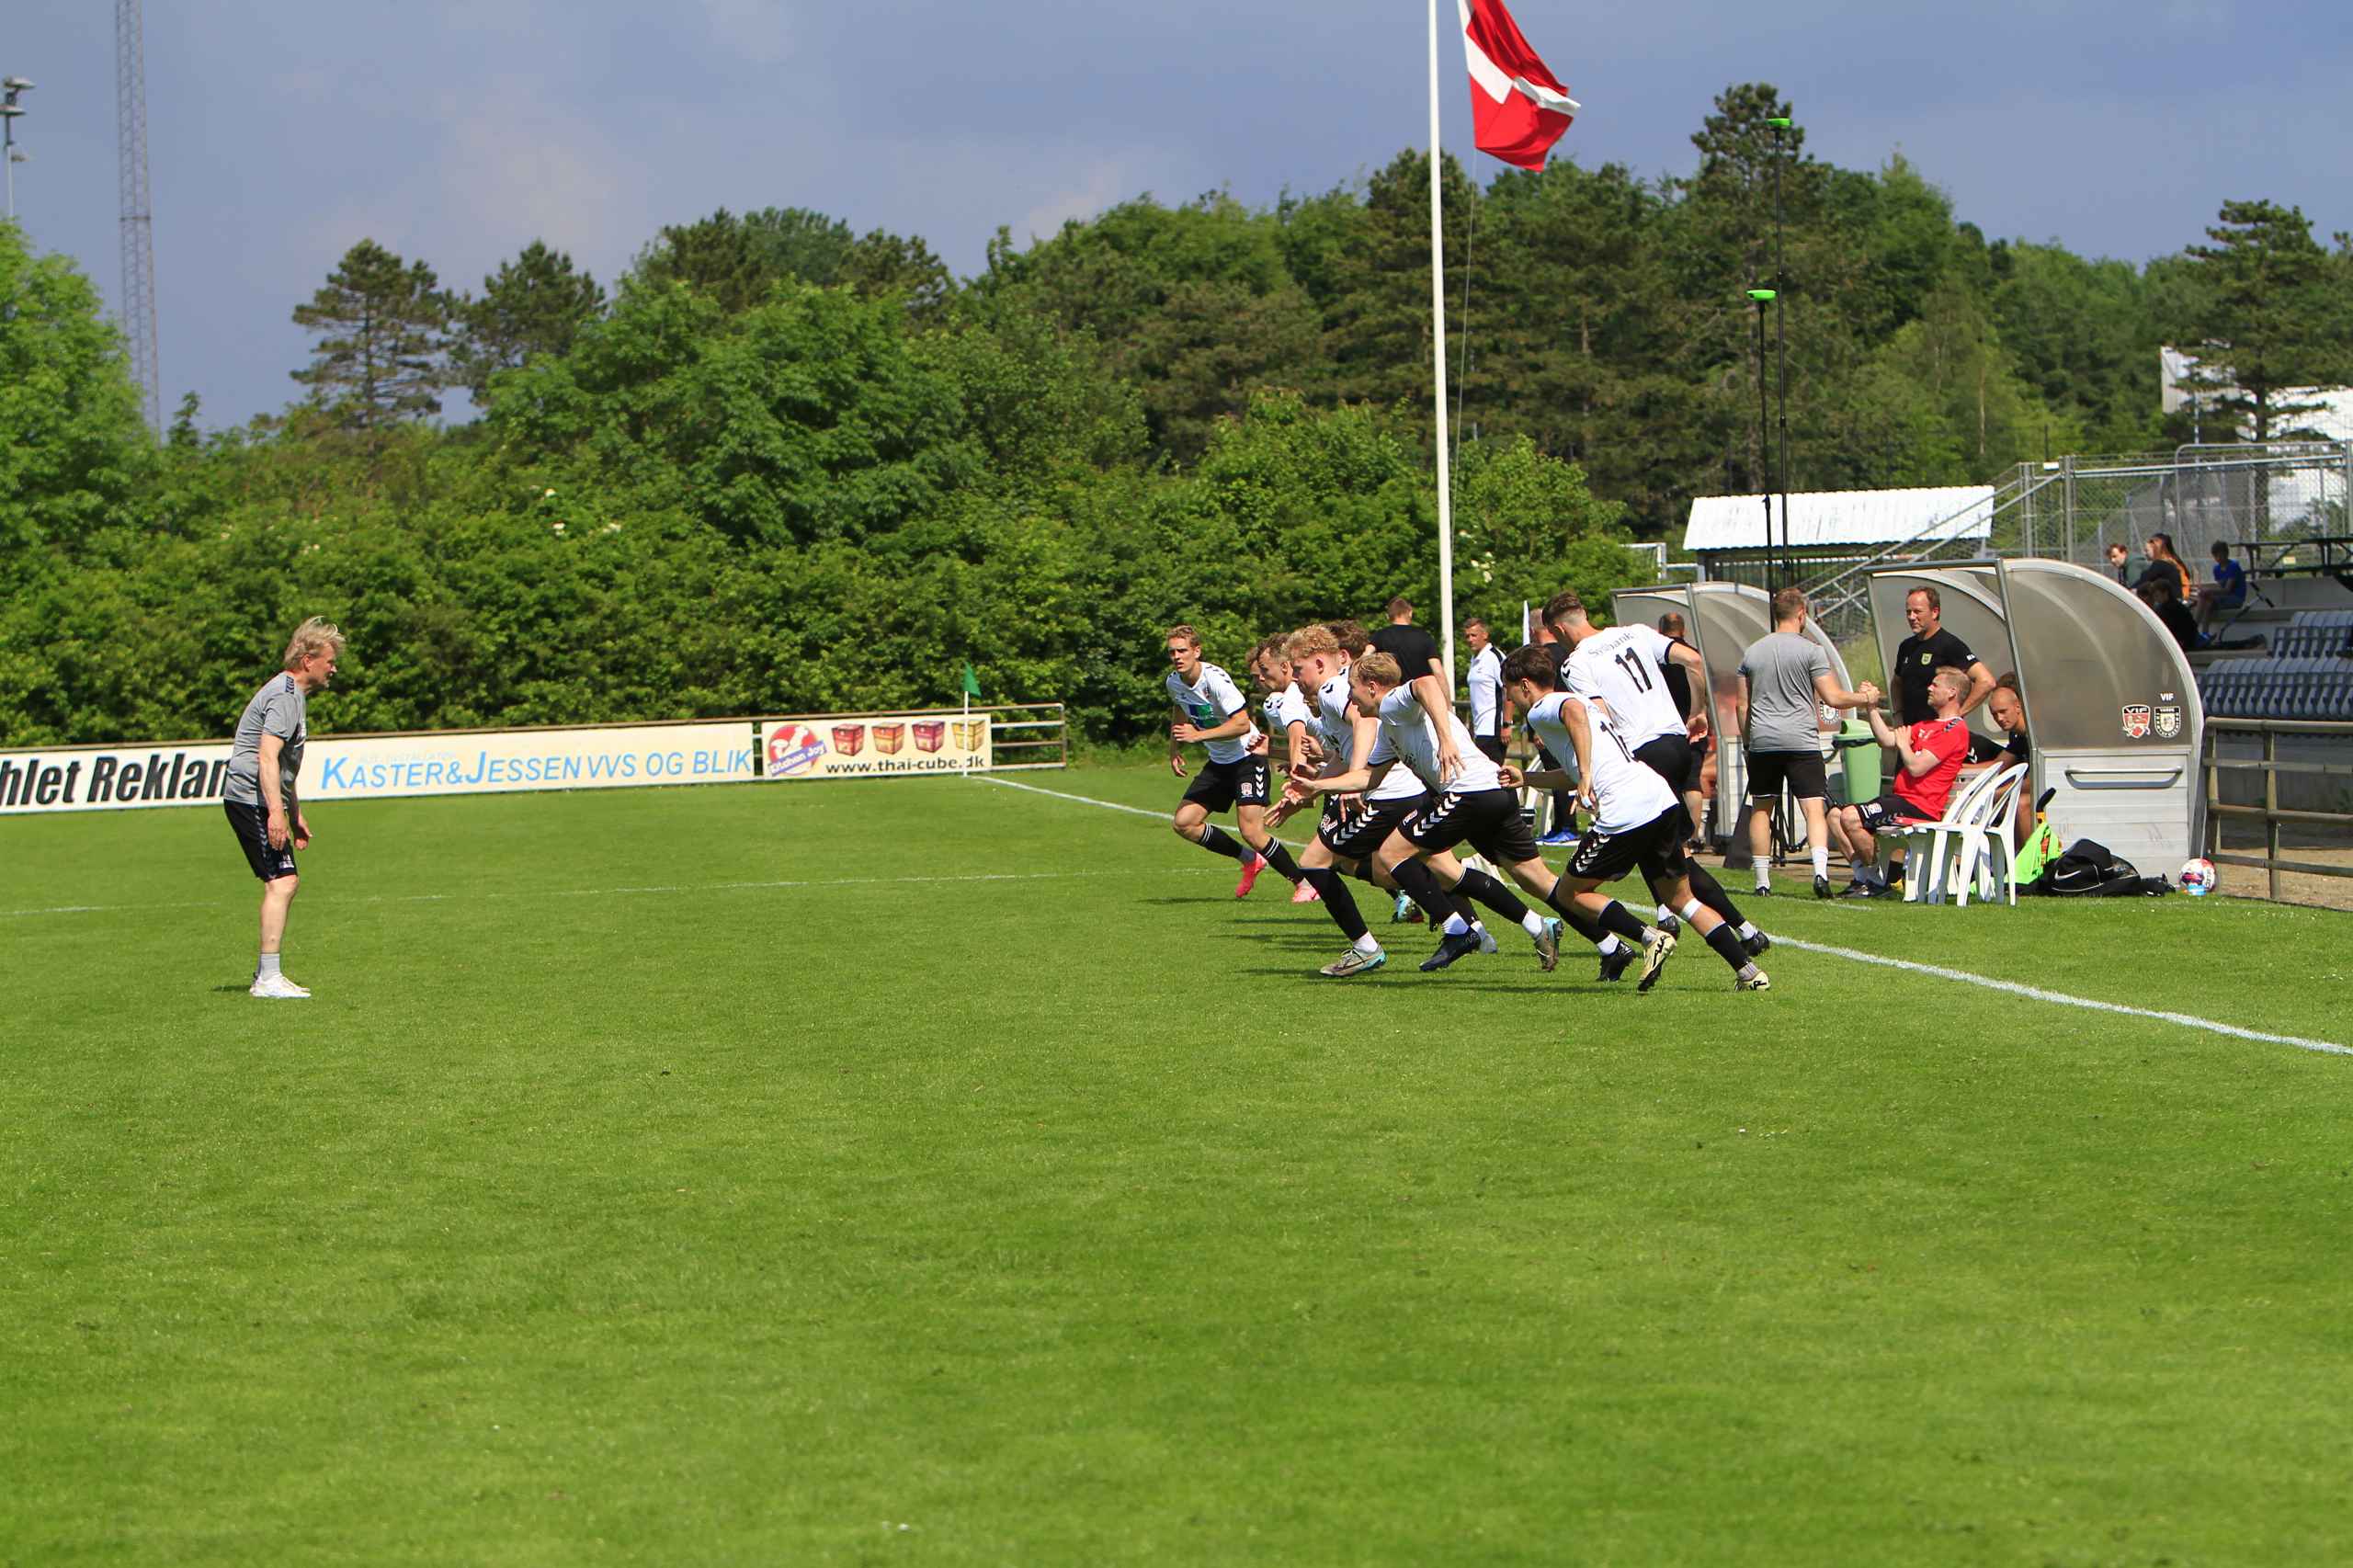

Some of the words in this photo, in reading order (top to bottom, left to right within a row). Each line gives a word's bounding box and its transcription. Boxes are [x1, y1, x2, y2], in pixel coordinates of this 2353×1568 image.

[1614, 646, 1654, 695] 11
[2160, 693, 2175, 701] VIF
[321, 750, 582, 790] KASTER&JESSEN
[587, 754, 637, 779] VVS
[645, 752, 685, 777] OG
[692, 749, 752, 775] BLIK
[826, 756, 984, 774] www.thai-cube.dk
